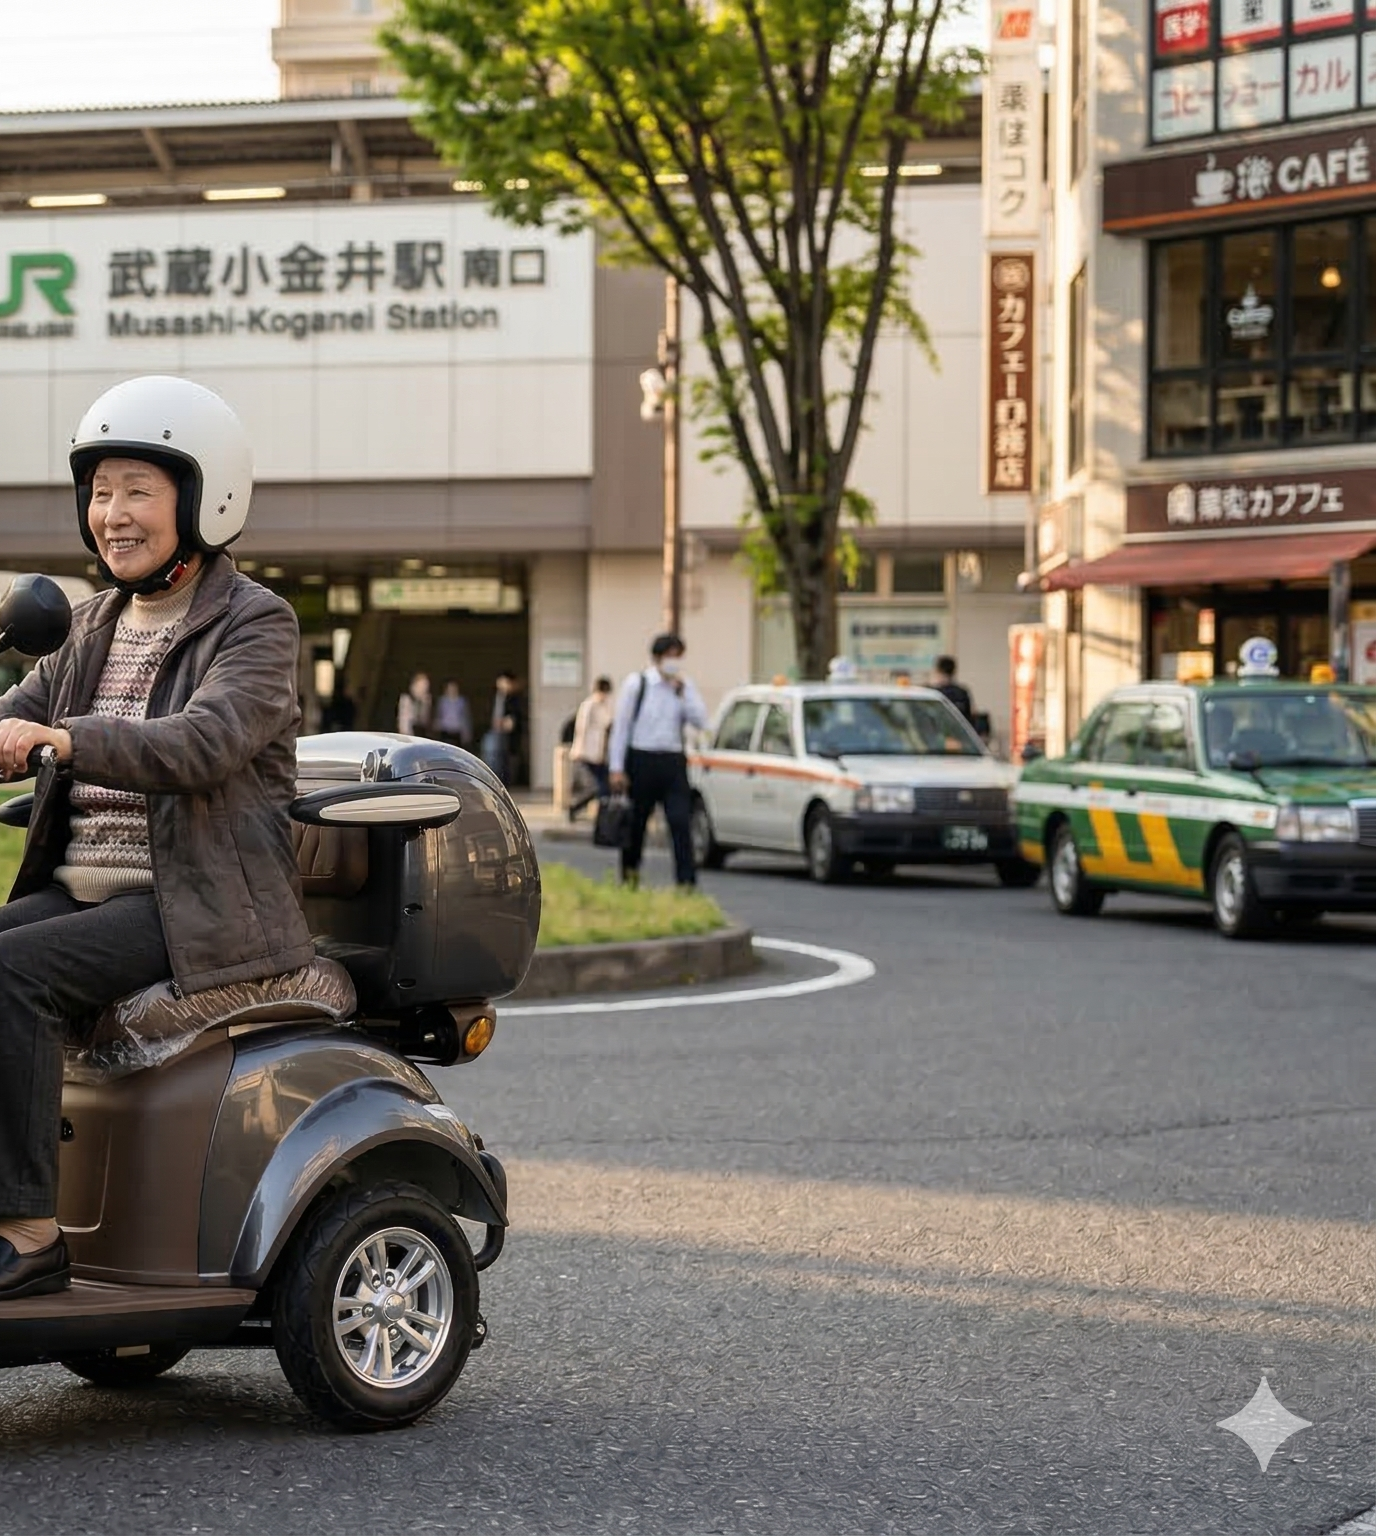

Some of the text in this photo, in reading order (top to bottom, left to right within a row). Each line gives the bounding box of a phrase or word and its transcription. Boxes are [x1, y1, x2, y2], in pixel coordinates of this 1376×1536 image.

[1277, 137, 1371, 193] CAFÉ
[108, 240, 545, 297] 武蔵小金井駅 南口
[108, 300, 374, 339] Musashi-Koganei
[387, 300, 499, 331] Station
